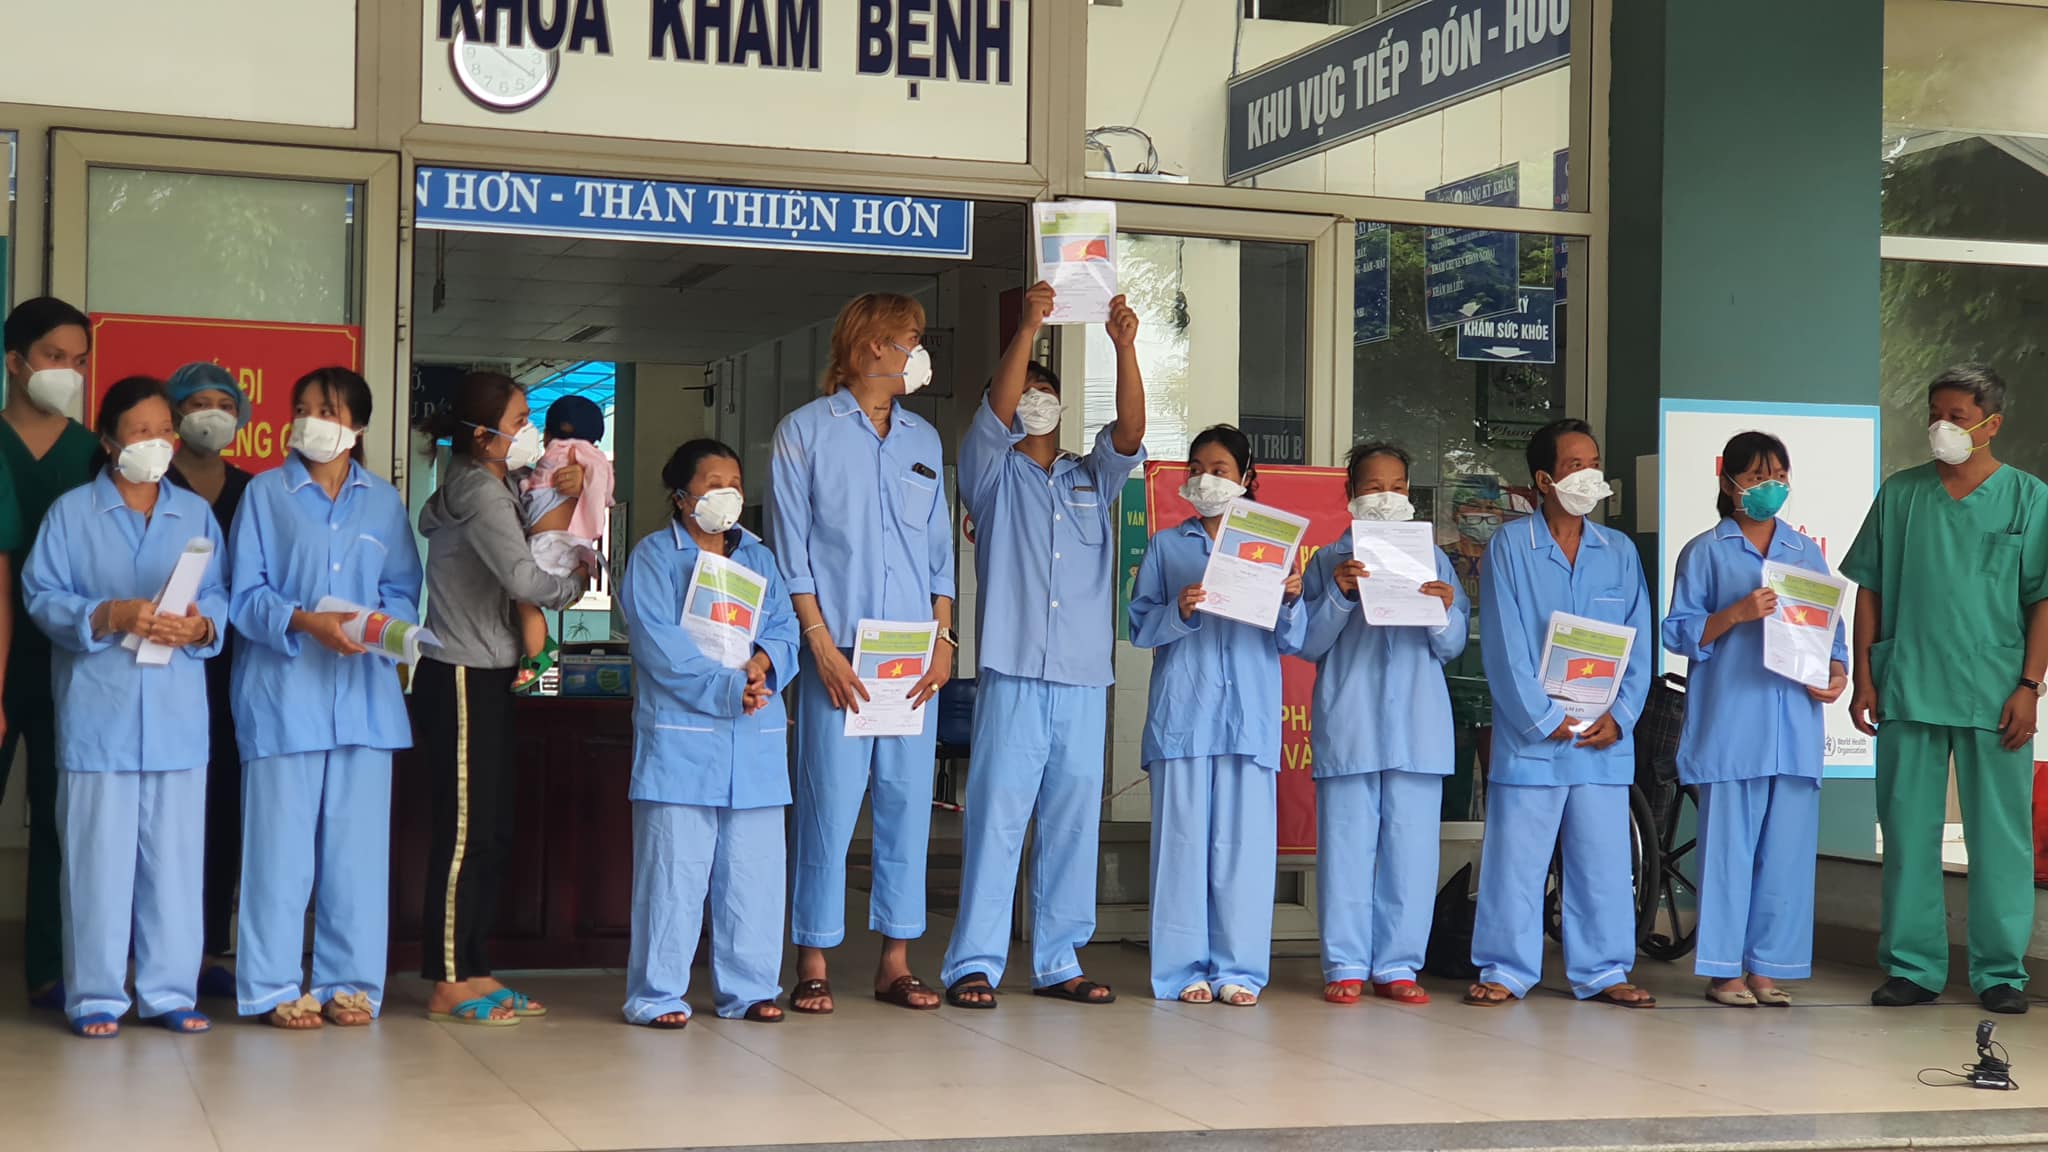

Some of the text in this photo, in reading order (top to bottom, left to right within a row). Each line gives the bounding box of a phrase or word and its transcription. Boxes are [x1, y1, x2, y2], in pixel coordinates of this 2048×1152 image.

[1248, 86, 1292, 150] KHU
[1299, 64, 1345, 136] VỰC
[1353, 28, 1409, 110] TIẾP
[1421, 6, 1482, 86] ĐÓN
[444, 172, 541, 214] HƠN
[575, 180, 696, 224] THÂN
[707, 190, 840, 238] THIỆN
[852, 197, 941, 238] HƠN
[1497, 319, 1519, 339] SỨC
[1521, 319, 1549, 341] KHỎE
[1263, 429, 1289, 460] TRÚ
[1281, 705, 1311, 731] PH
